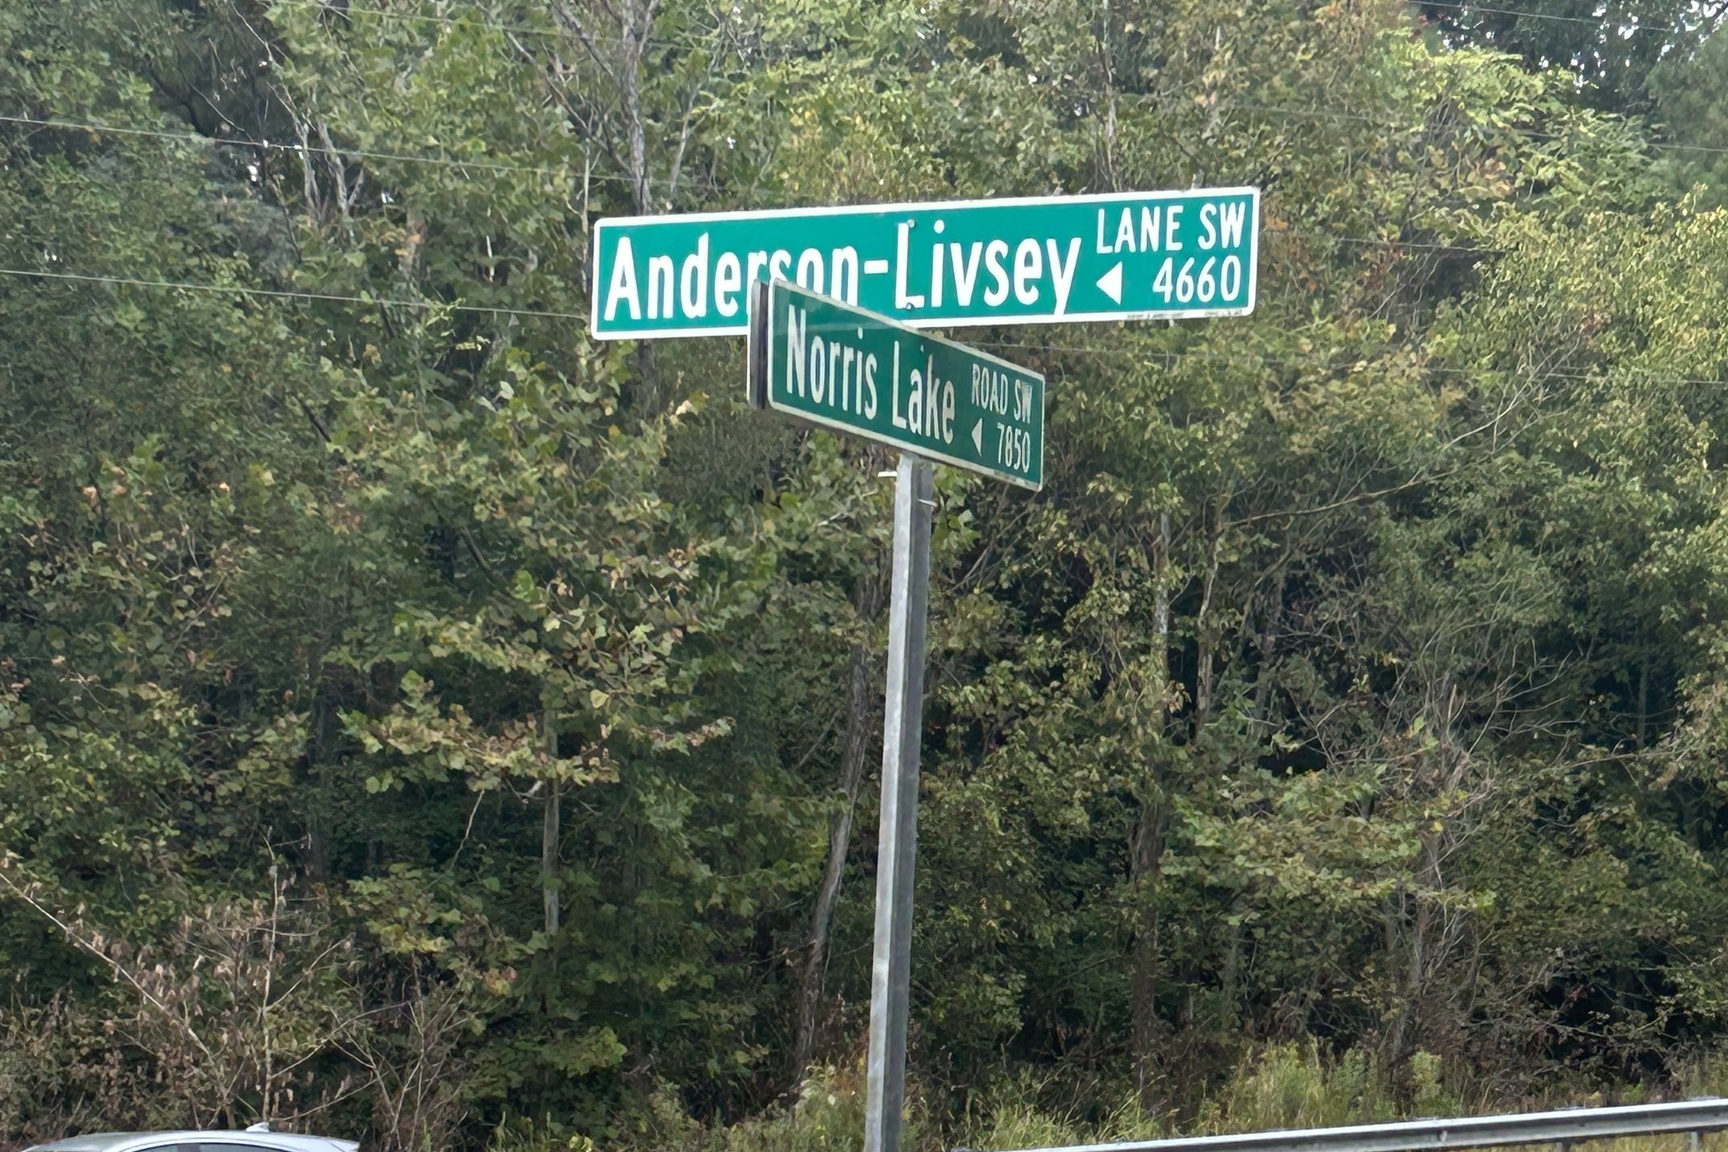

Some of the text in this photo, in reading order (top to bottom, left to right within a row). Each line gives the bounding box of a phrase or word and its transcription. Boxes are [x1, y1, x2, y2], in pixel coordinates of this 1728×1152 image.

[604, 201, 1246, 321] Anderson-Livsey LANE SW
[1152, 254, 1242, 304] 4660
[786, 303, 1033, 446] Norris Lake ROAD SW
[997, 422, 1031, 474] 7850
